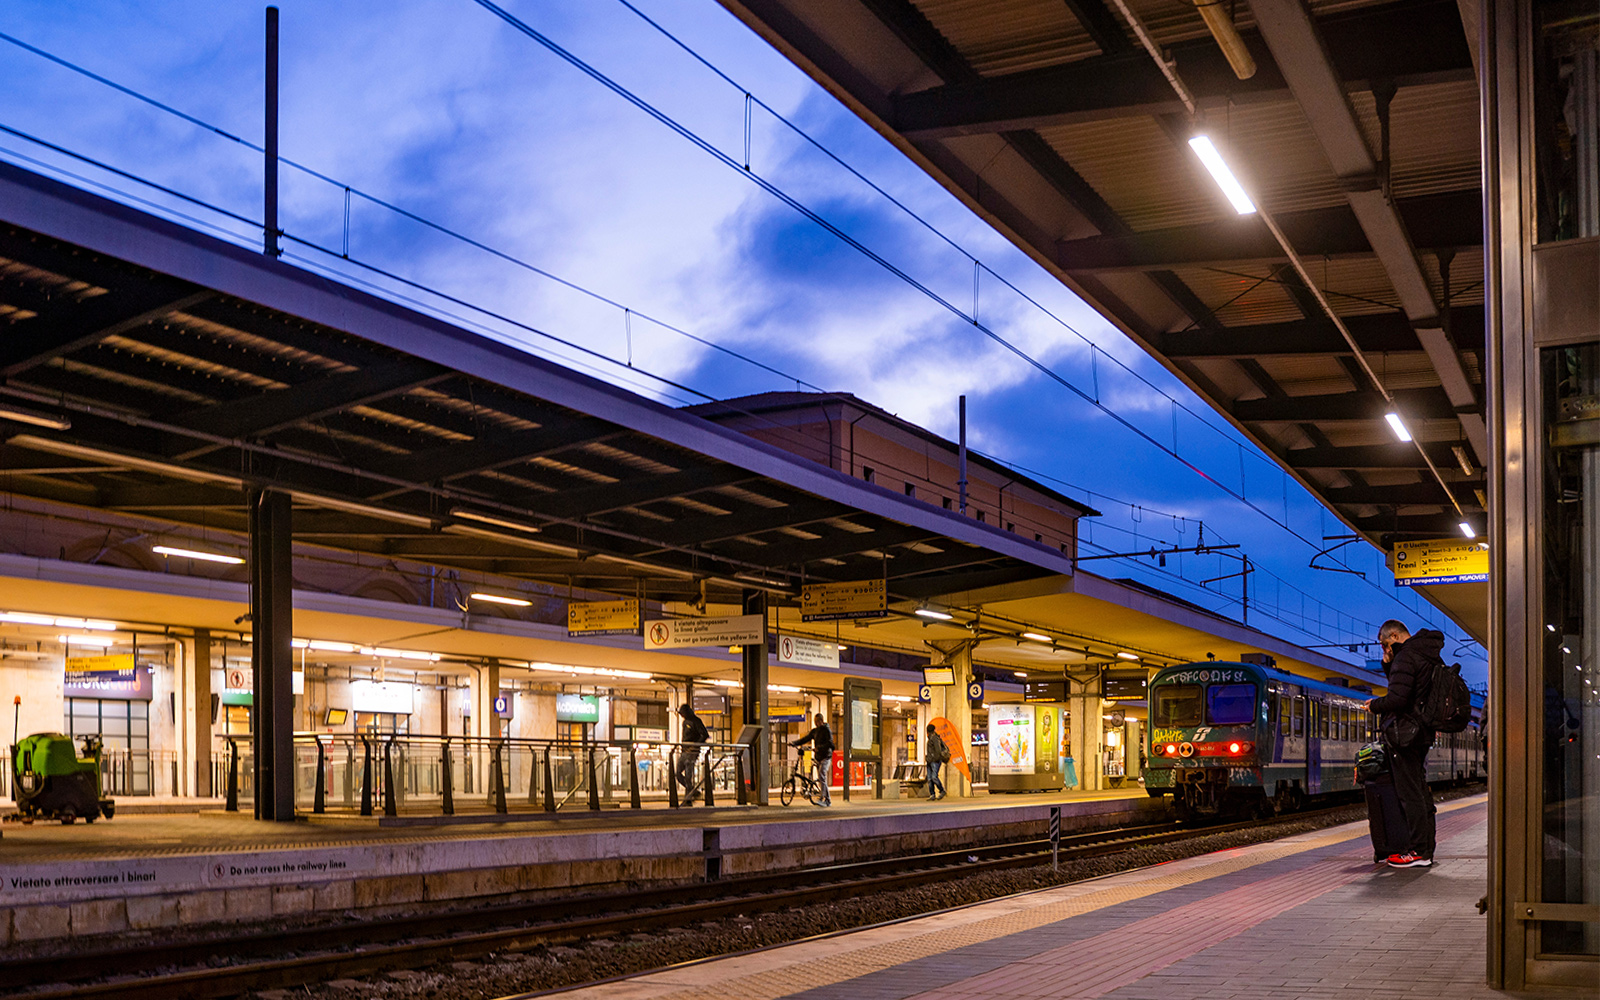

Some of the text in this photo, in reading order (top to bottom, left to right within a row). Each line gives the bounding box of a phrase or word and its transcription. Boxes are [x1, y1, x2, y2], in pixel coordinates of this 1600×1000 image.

[1397, 561, 1417, 569] Treni
[1411, 577, 1440, 585] Aeroporto
[696, 618, 728, 627] oltrepassare
[699, 634, 720, 643] beyond
[730, 633, 748, 642] yellow
[972, 686, 979, 696] 3
[230, 859, 346, 876] Do not cross the railway lines
[11, 876, 51, 889] Vietato
[54, 873, 119, 887] attraversare
[127, 870, 156, 883] binari
